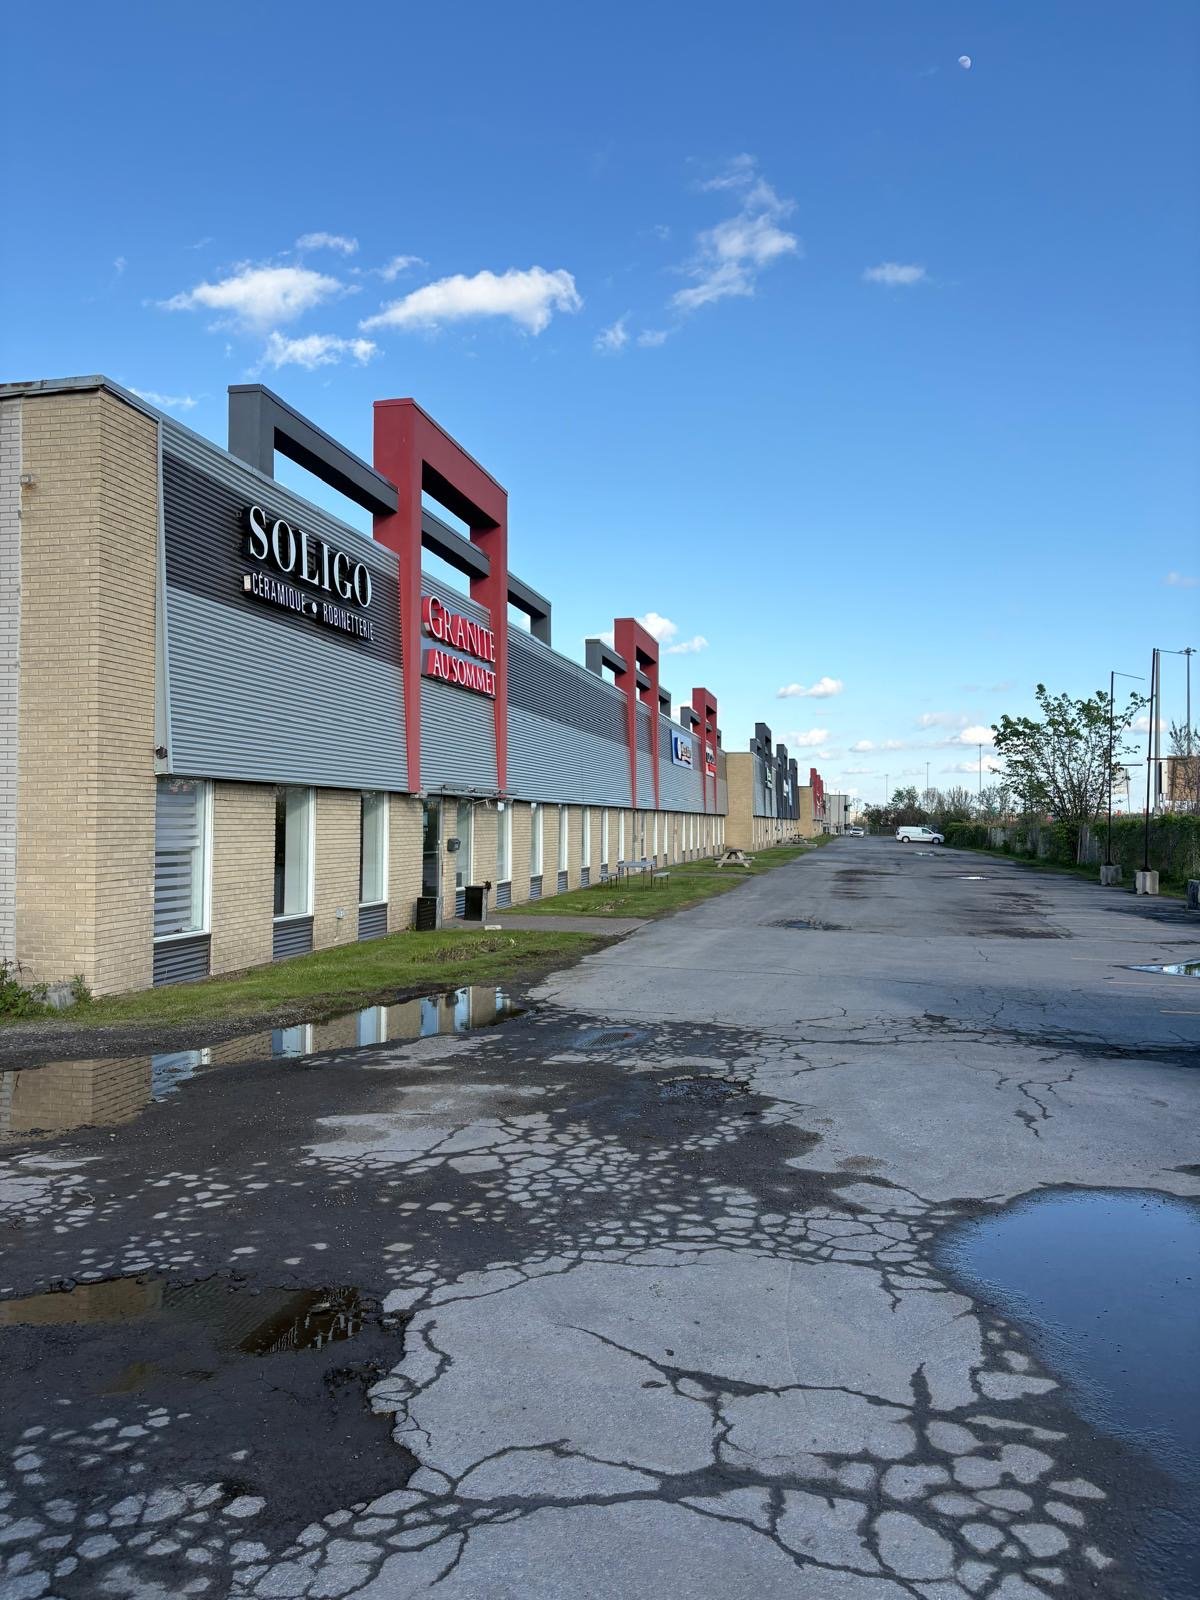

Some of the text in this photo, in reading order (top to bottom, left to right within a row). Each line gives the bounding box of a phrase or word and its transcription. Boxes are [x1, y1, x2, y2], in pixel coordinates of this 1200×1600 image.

[249, 505, 372, 609] SOLIGO
[252, 572, 374, 641] CÉRAMIQUE ROBINETTERIE
[429, 595, 496, 663] GRANITE
[433, 649, 497, 696] AU SOMMET
